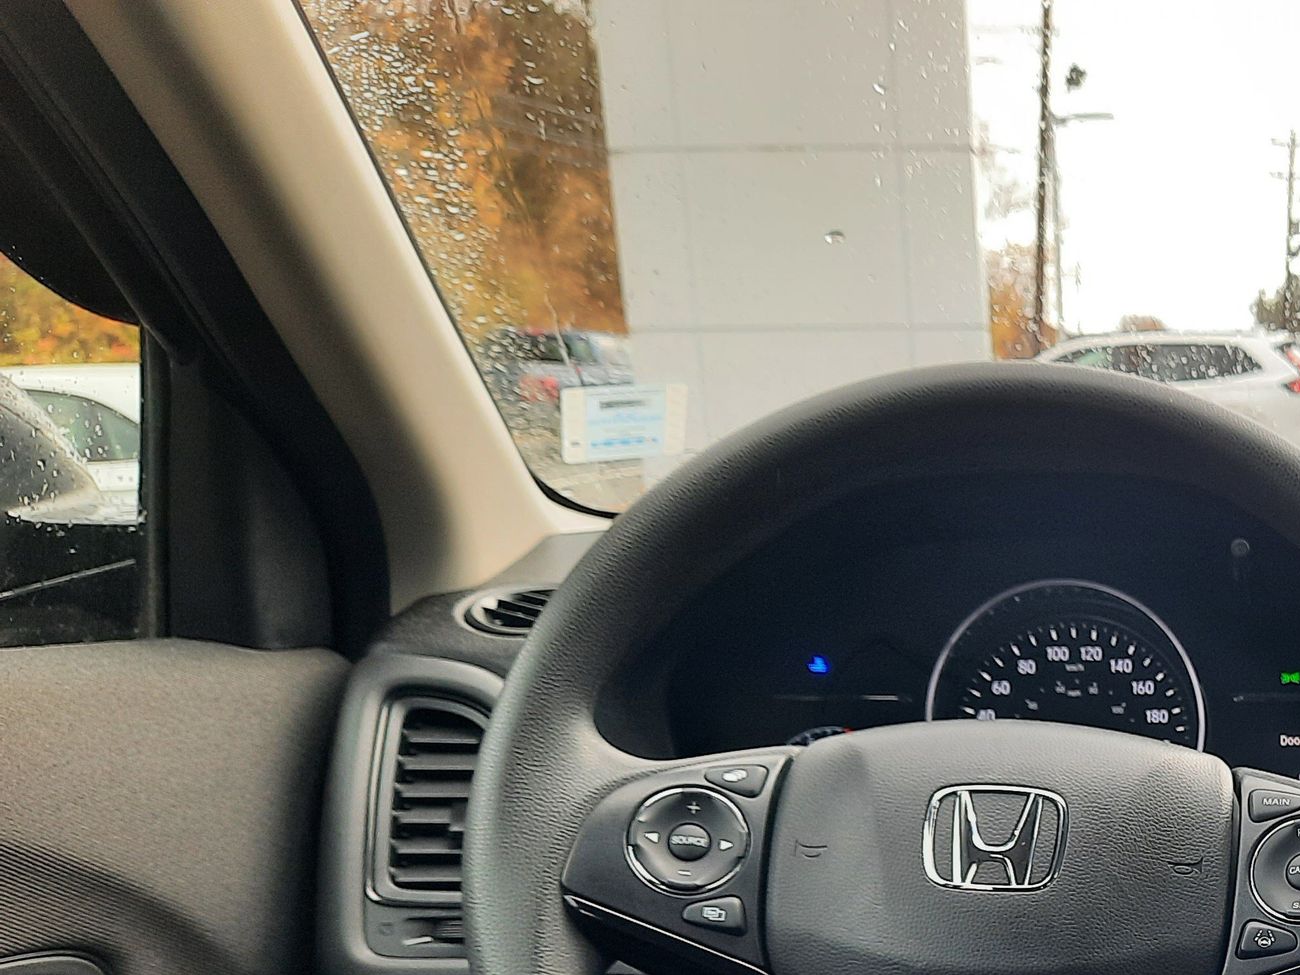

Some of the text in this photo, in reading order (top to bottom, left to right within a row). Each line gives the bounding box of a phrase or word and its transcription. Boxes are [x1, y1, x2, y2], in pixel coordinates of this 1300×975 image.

[1046, 646, 1070, 661] 100
[1080, 646, 1103, 661] 120
[1017, 659, 1036, 675] 80
[1110, 659, 1133, 674] 140
[991, 681, 1010, 696] 60
[1131, 681, 1155, 696] 160
[1146, 709, 1169, 724] 180
[1262, 797, 1291, 806] MAIN
[670, 834, 709, 847] SOURCE
